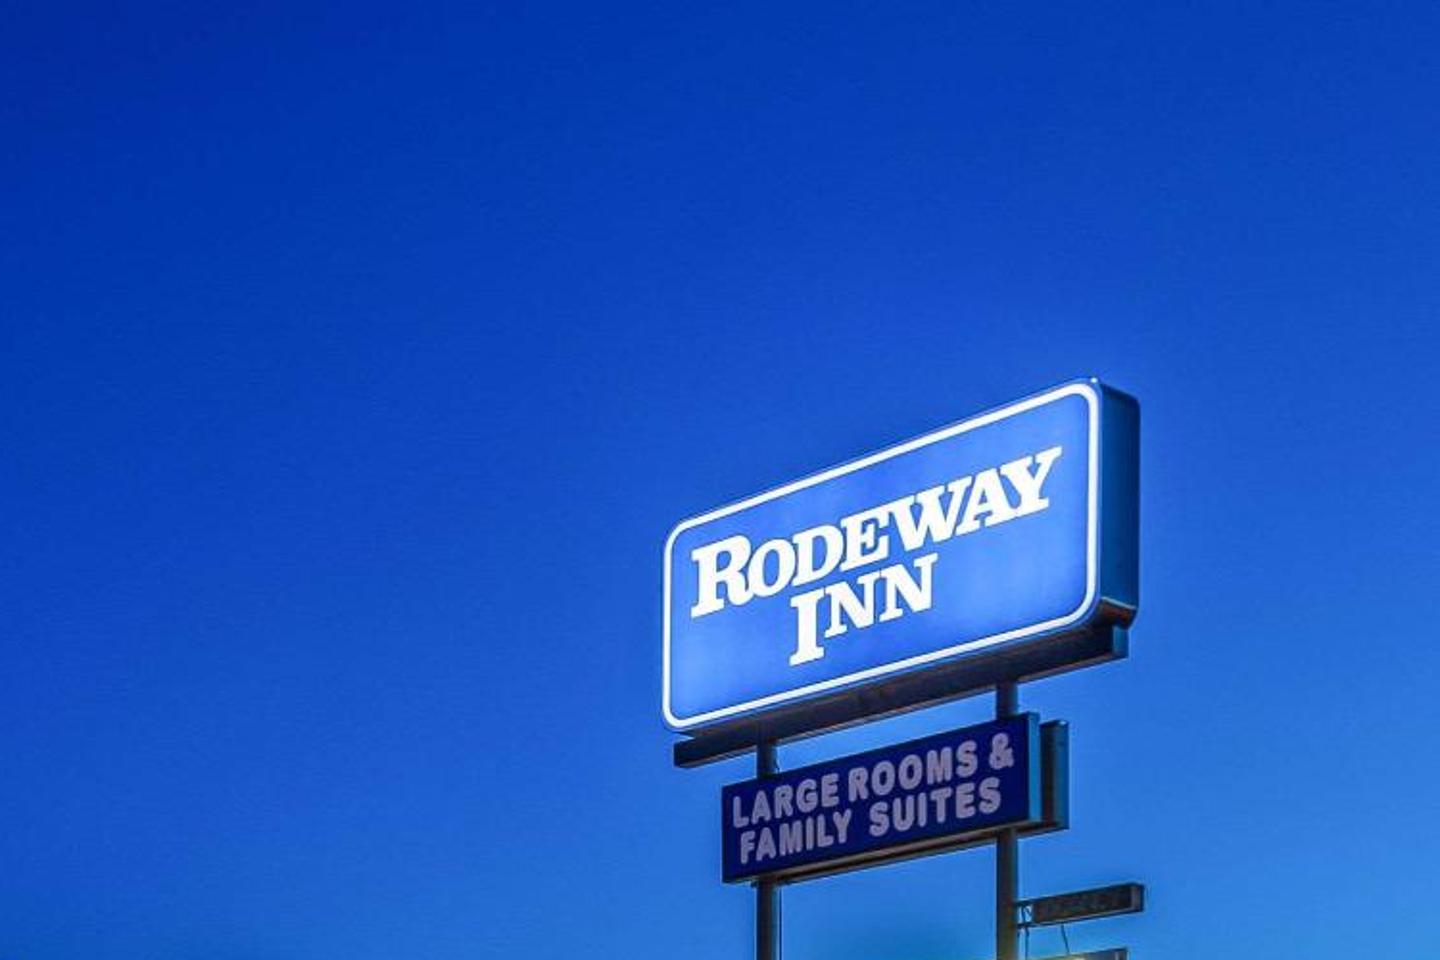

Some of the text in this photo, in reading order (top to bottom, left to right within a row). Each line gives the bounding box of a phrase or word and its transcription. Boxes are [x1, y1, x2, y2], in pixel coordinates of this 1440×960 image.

[691, 446, 1062, 617] RODEWAY
[789, 553, 938, 666] INN
[732, 733, 1014, 828] LARGE ROOMS &
[740, 777, 1001, 864] FAMILY SUITES
